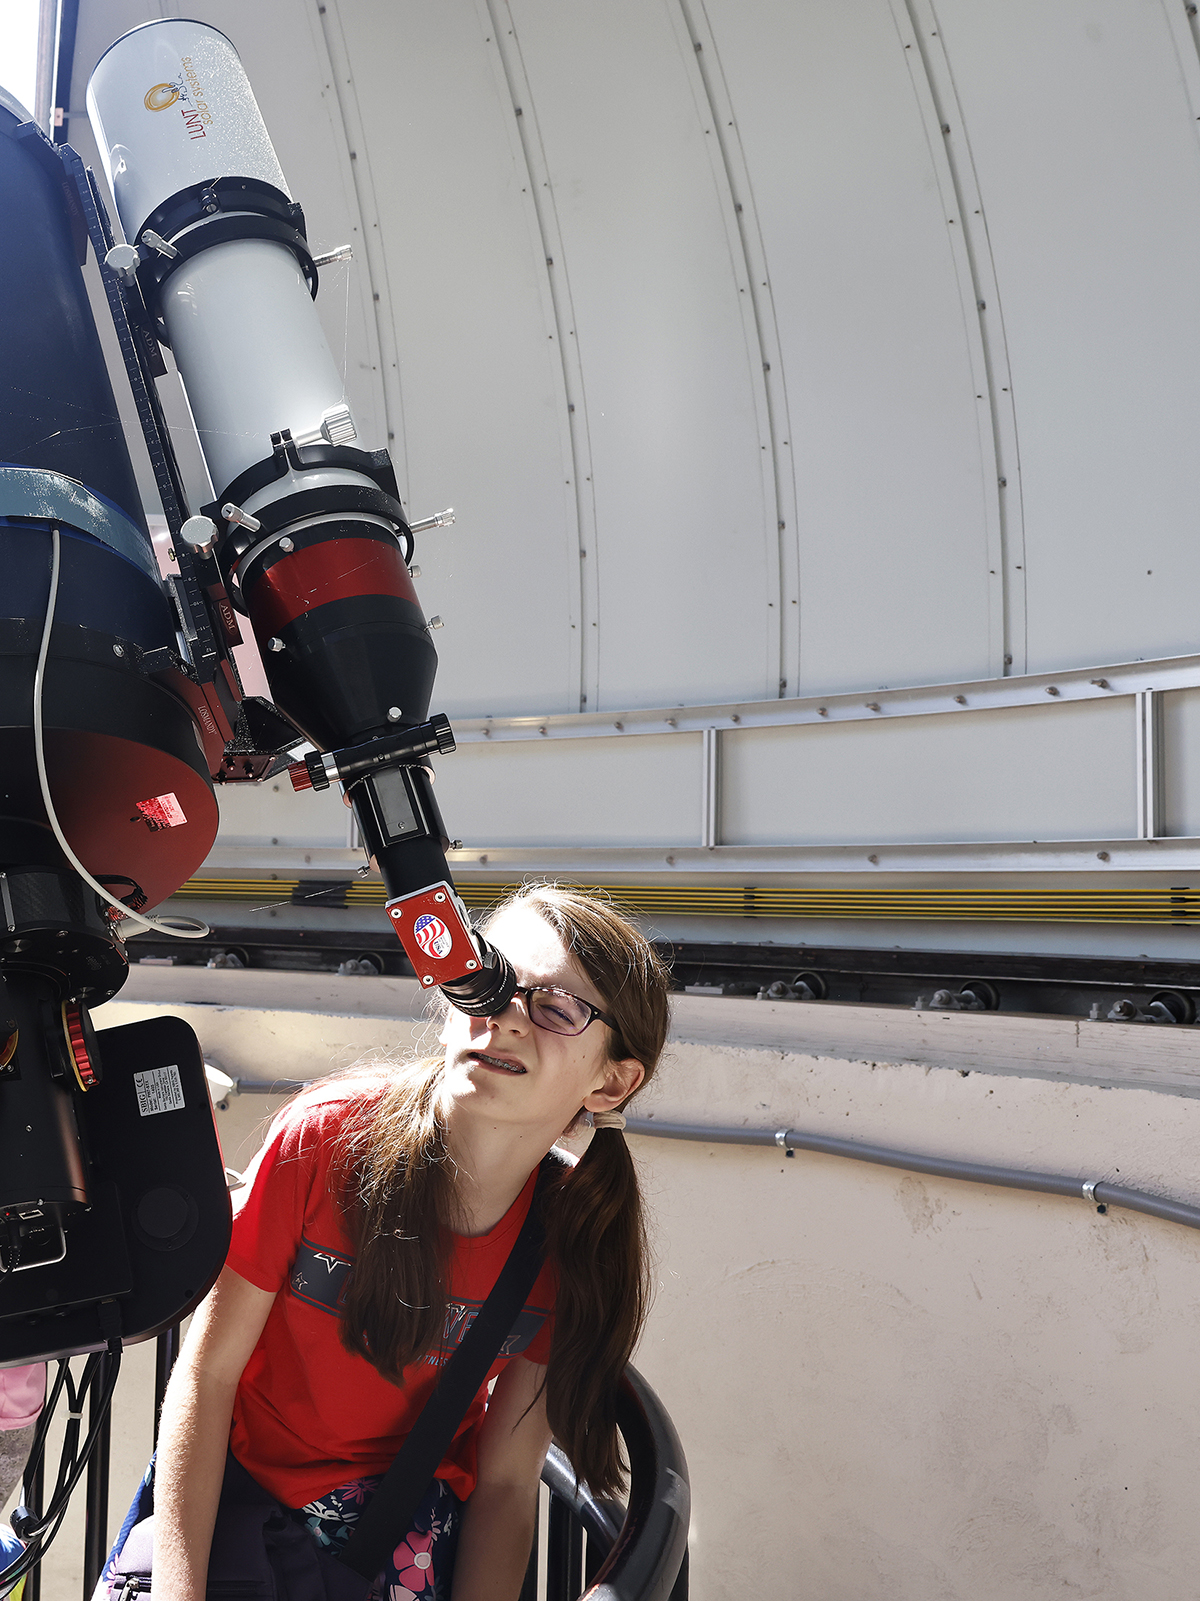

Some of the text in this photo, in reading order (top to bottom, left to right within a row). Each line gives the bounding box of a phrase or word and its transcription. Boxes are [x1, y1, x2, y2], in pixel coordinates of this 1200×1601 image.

[181, 57, 214, 125] solar systems
[181, 109, 207, 140] LUNT
[142, 329, 157, 358] ADM
[220, 604, 237, 631] ADM
[197, 705, 216, 735] LOSMANDY
[139, 1094, 147, 1112] SBIG
